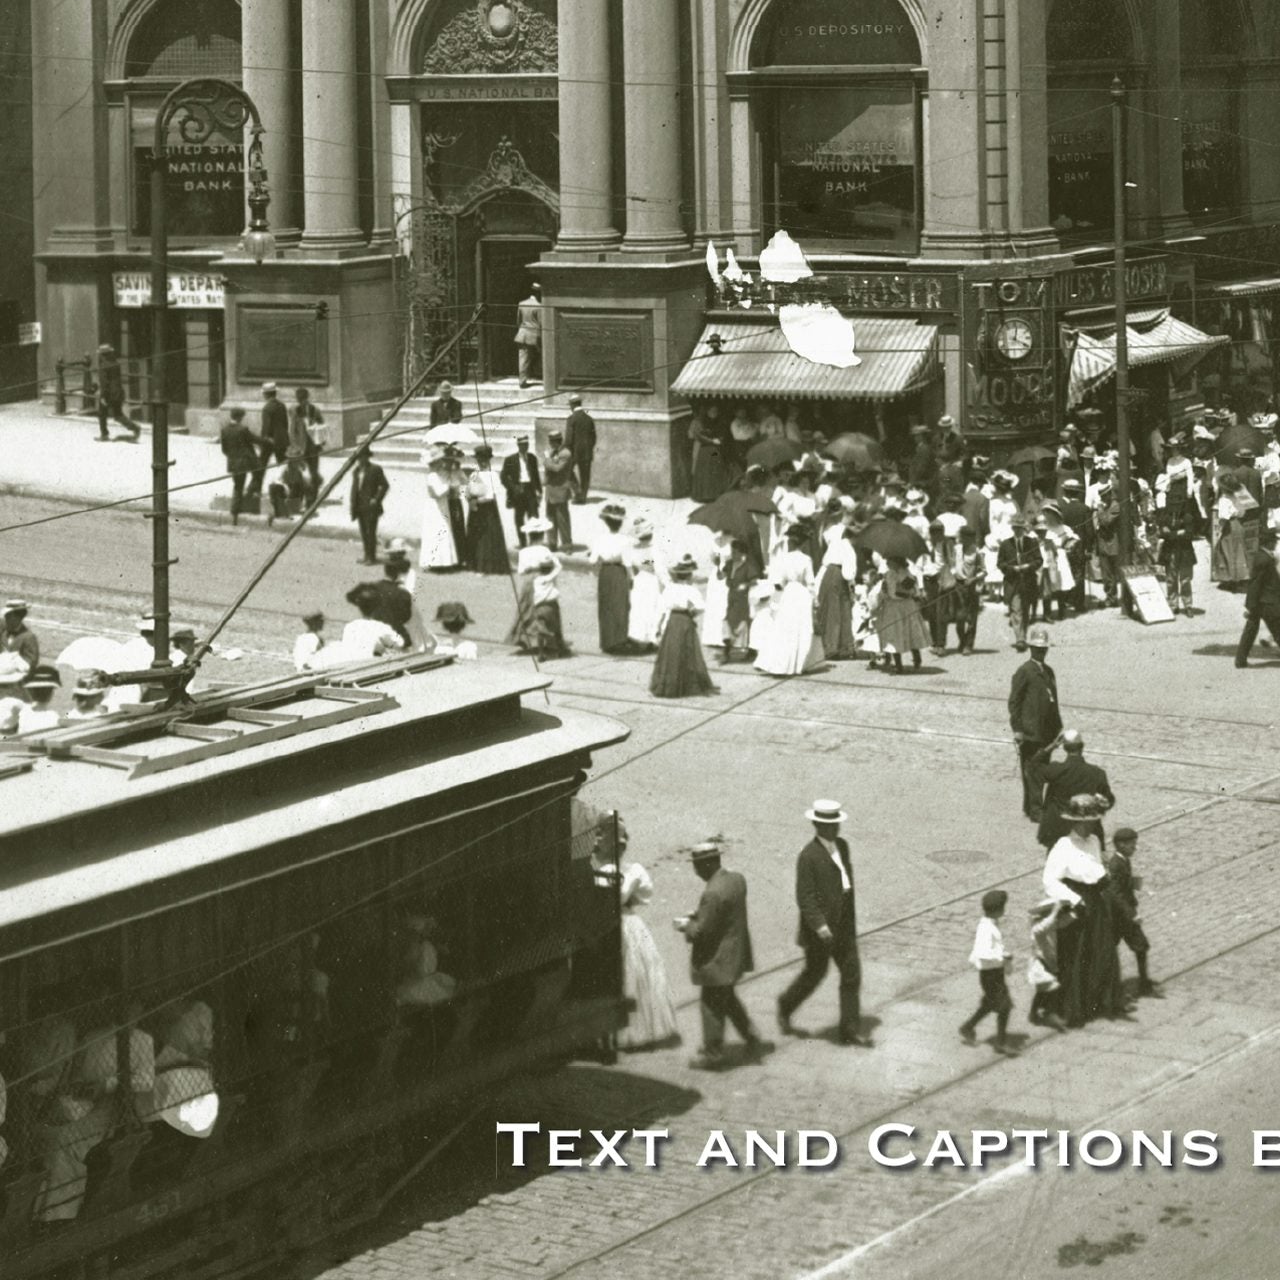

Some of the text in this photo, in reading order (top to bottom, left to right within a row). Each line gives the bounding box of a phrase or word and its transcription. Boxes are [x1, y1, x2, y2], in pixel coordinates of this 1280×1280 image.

[808, 23, 905, 36] DEPOSITORY
[459, 87, 528, 99] NATIONAL
[168, 161, 245, 174] NATIONAL
[1063, 171, 1091, 184] BANK
[184, 180, 233, 192] BANK
[825, 180, 868, 193] BANK
[969, 280, 1048, 310] TOM
